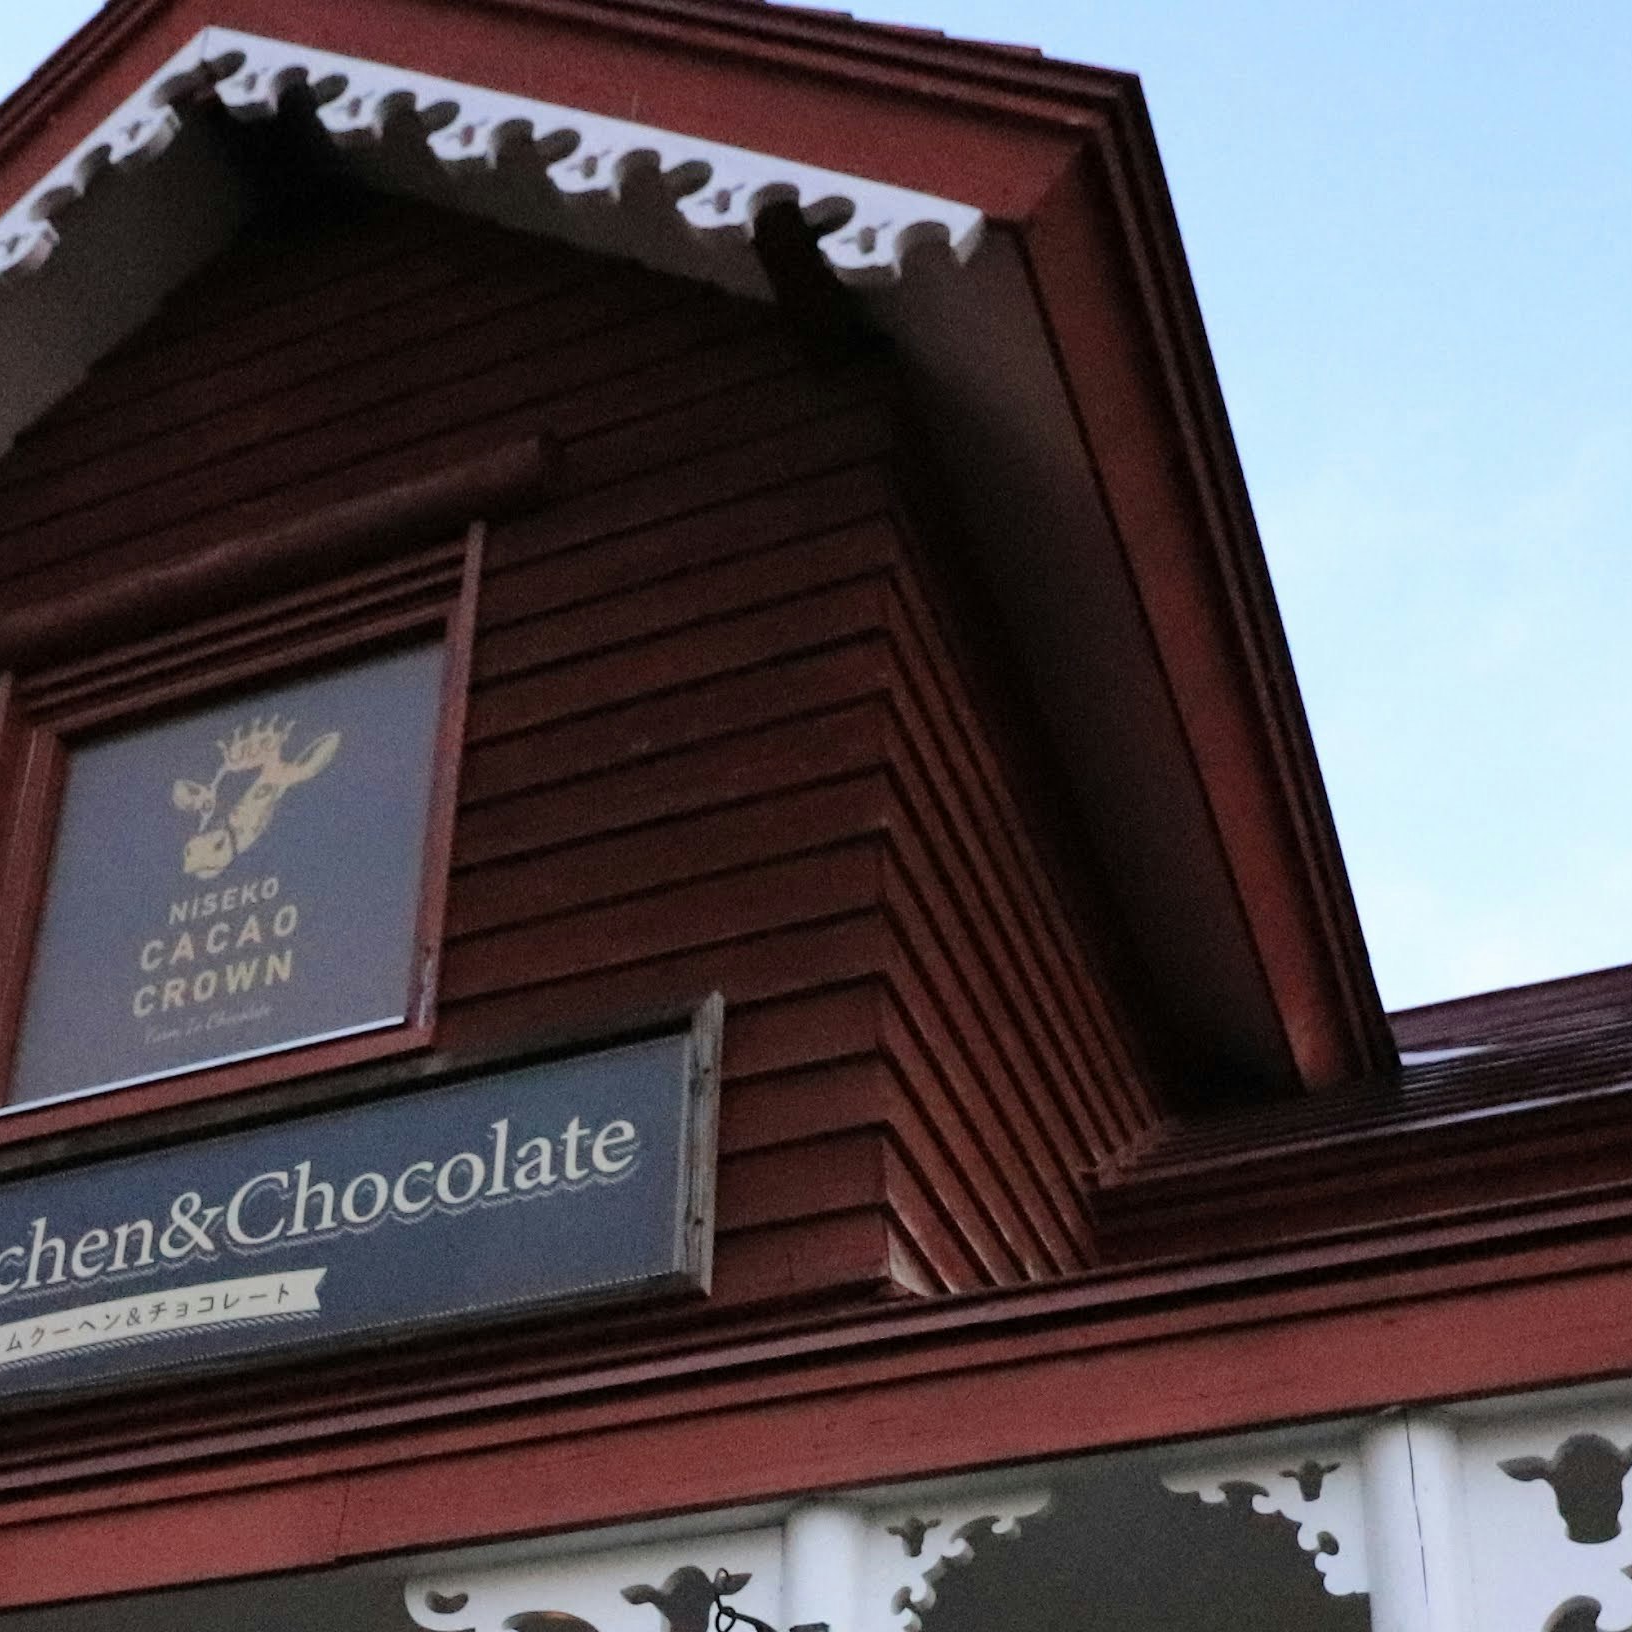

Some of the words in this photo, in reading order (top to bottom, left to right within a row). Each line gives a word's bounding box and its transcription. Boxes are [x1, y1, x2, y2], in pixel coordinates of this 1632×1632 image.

[168, 876, 279, 925] NISEKO
[140, 904, 298, 972] CACAO
[133, 949, 293, 1018] CROWN
